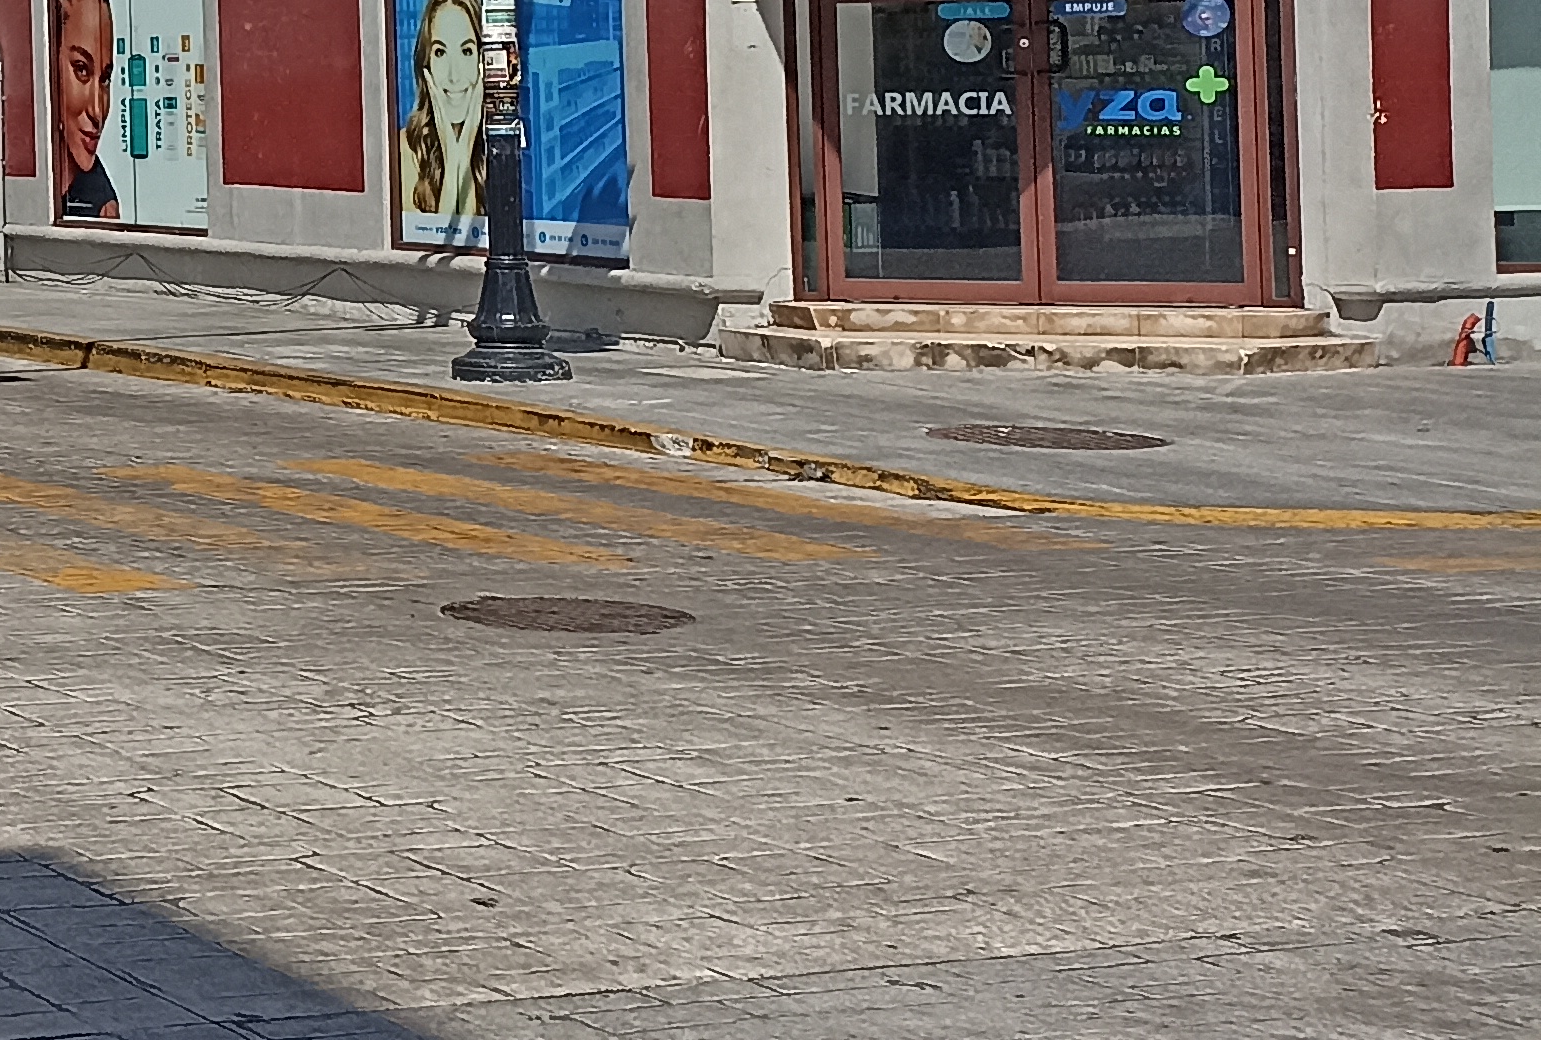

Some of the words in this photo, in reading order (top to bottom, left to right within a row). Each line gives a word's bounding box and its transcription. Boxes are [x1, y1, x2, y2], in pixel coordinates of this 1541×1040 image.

[1065, 2, 1115, 13] EMPUJE
[846, 91, 1013, 116] FARMACIA
[1057, 89, 1182, 130] yza
[154, 98, 162, 150] TRATA
[1086, 125, 1181, 136] FARMACIAS
